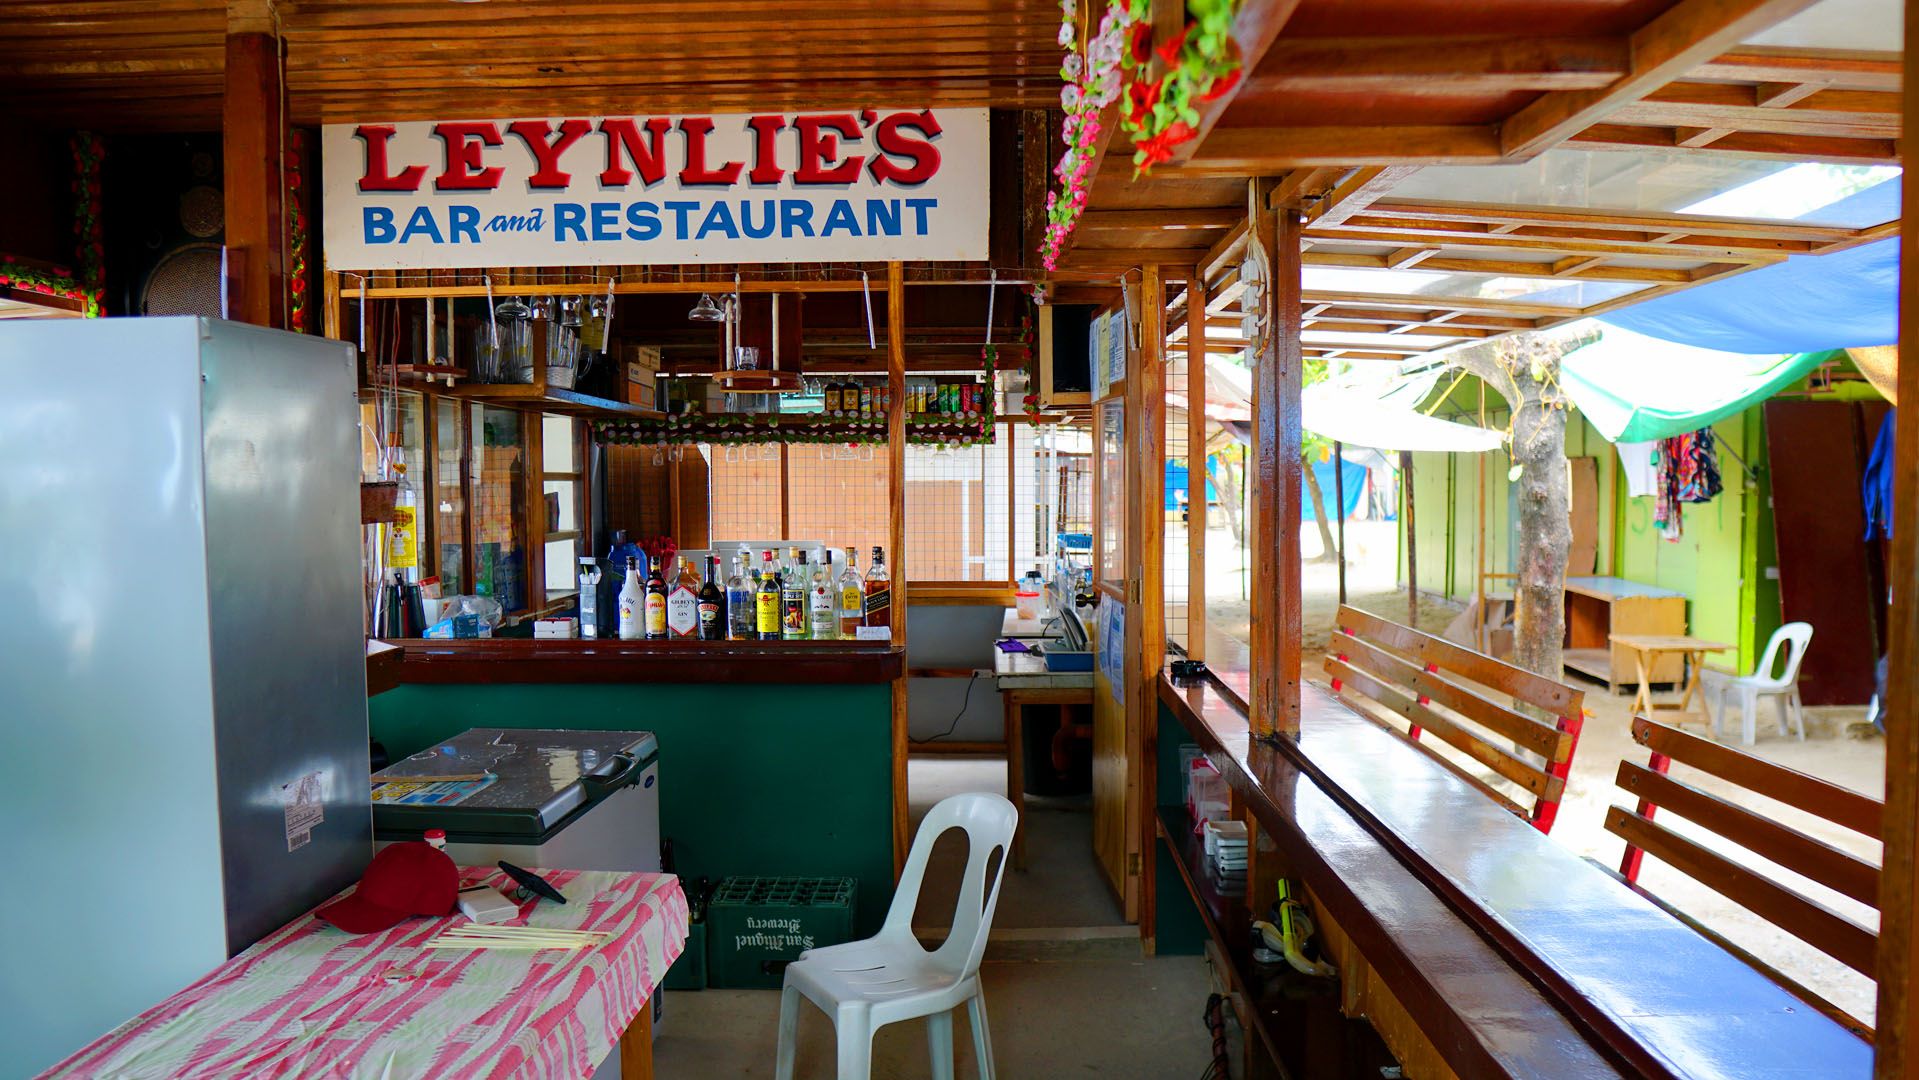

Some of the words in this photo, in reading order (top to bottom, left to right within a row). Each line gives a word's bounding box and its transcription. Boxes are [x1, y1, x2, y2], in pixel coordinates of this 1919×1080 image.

[353, 109, 943, 196] LEYNLIE'S
[363, 205, 481, 244] BAR
[483, 208, 547, 232] and
[553, 198, 938, 242] RESTAURANT
[747, 917, 801, 933] Brewery
[736, 932, 784, 951] Miguel
[786, 935, 814, 950] San
